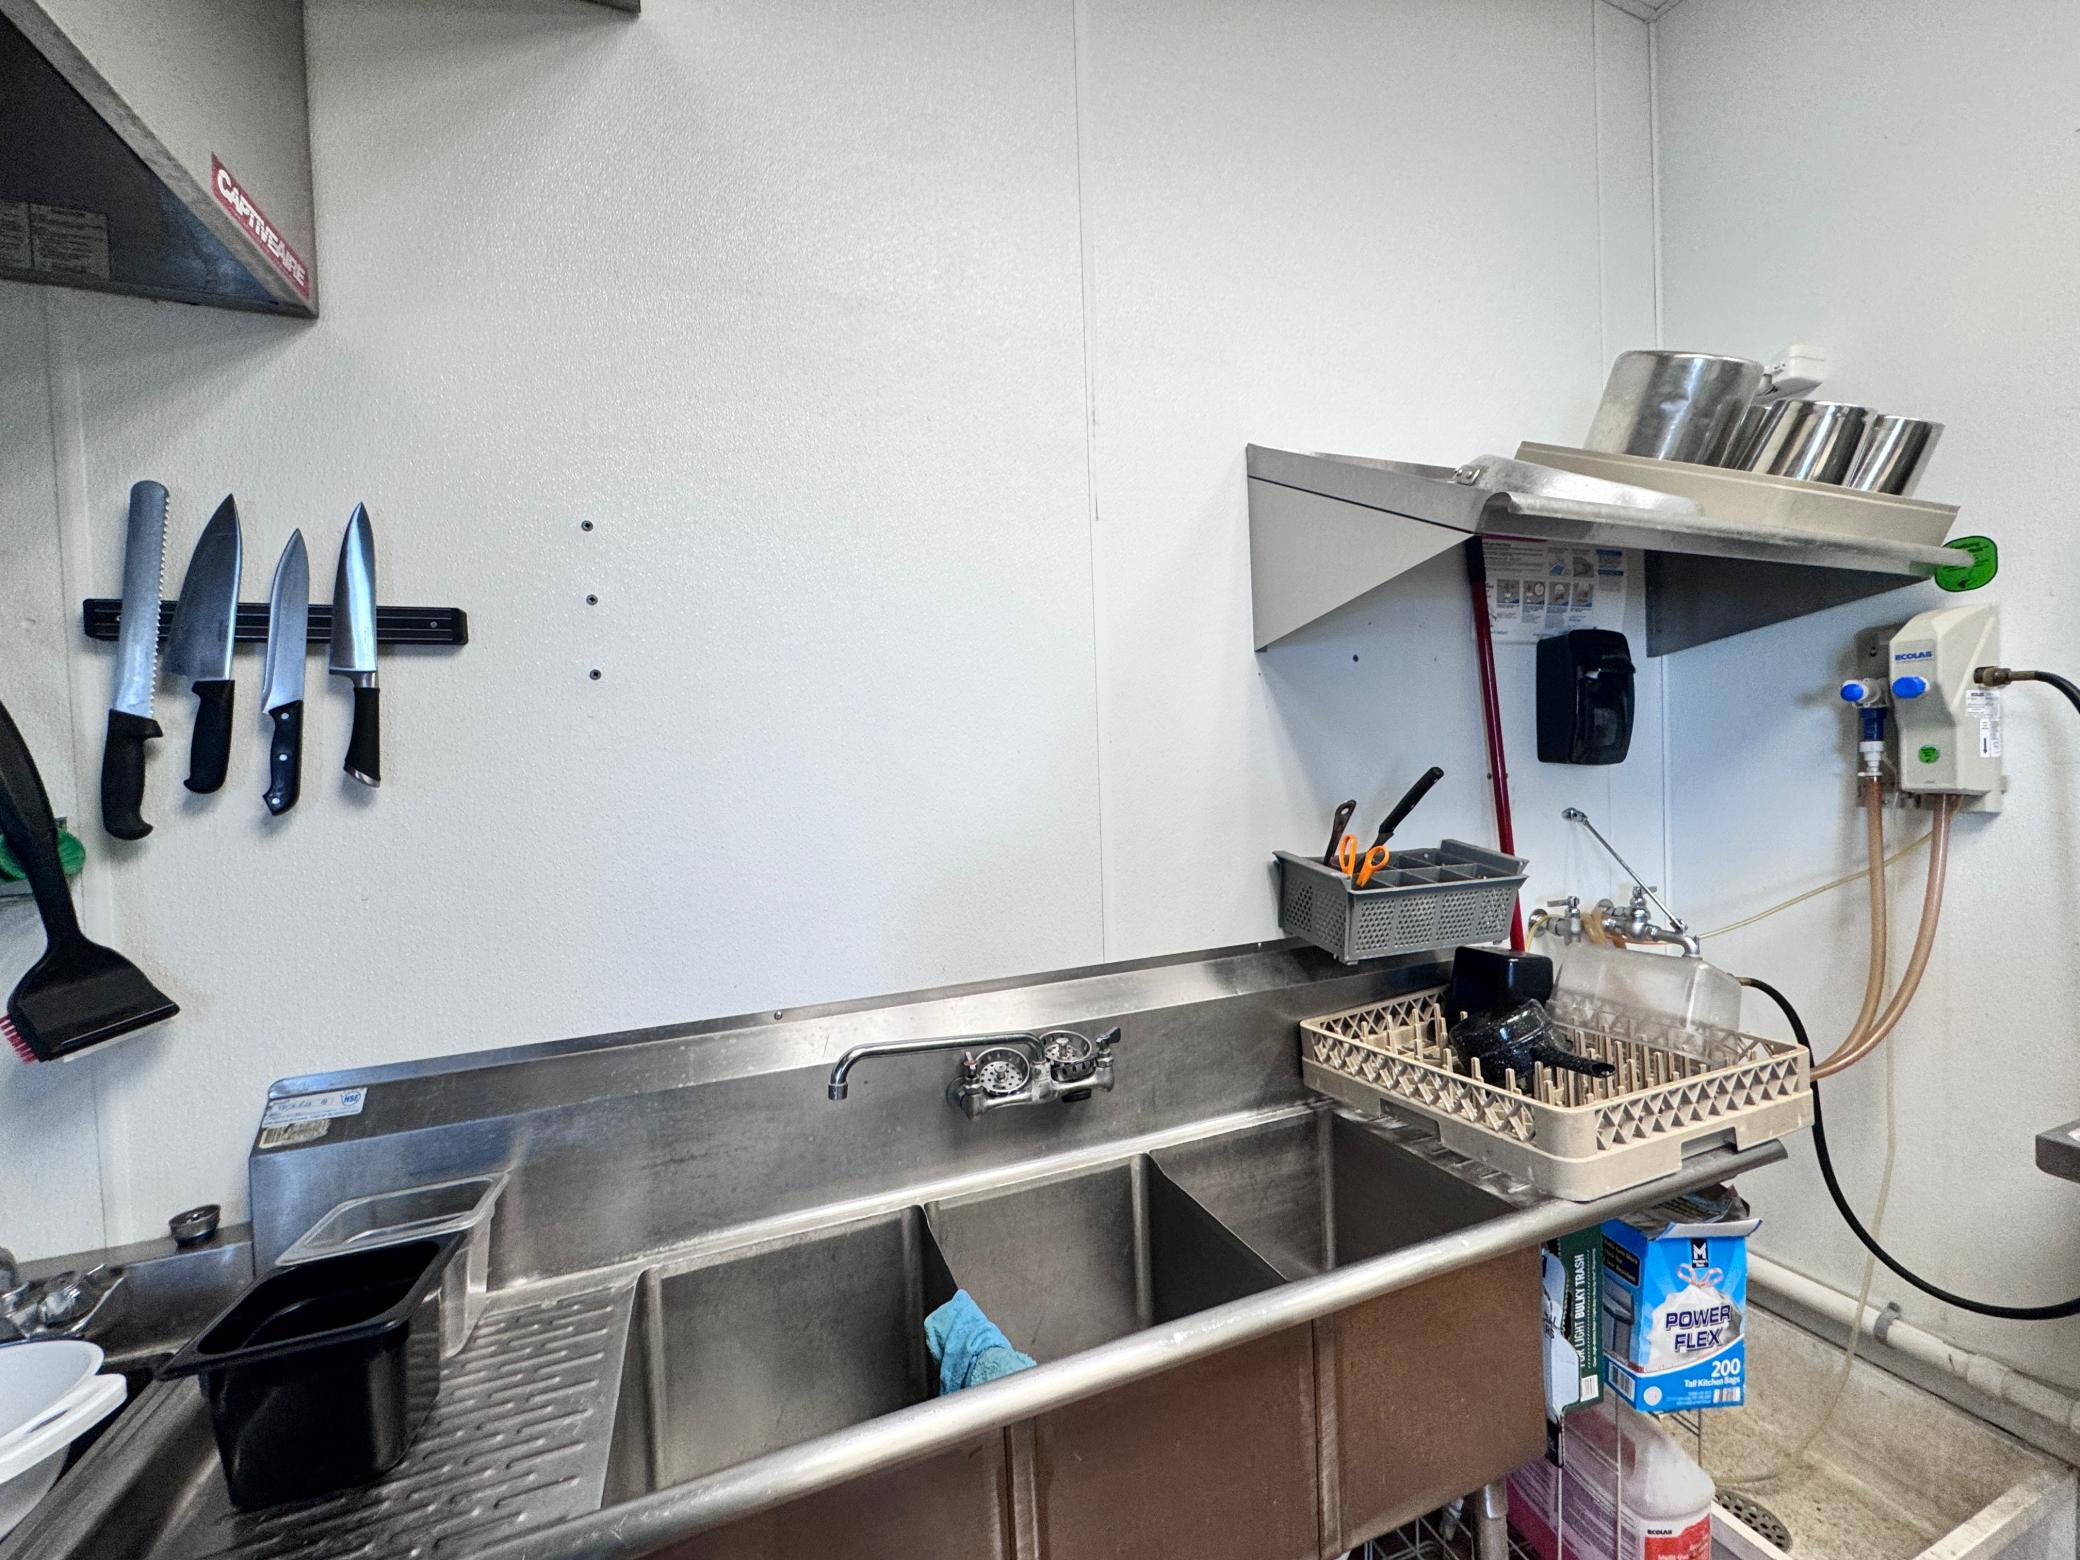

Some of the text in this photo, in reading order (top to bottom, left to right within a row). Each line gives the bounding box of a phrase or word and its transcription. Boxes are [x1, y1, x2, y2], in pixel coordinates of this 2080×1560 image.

[1895, 651, 1932, 661] ECOLAB
[1693, 1242, 1707, 1260] M
[1575, 1254, 1585, 1287] TRASH
[1575, 1288, 1585, 1320] BULKY
[1665, 1305, 1732, 1331] POWER
[1574, 1321, 1585, 1348] LIGHT
[1674, 1328, 1723, 1353] FLEX
[1711, 1358, 1741, 1377] 200
[1684, 1376, 1741, 1388] Tall Kitchen Bags
